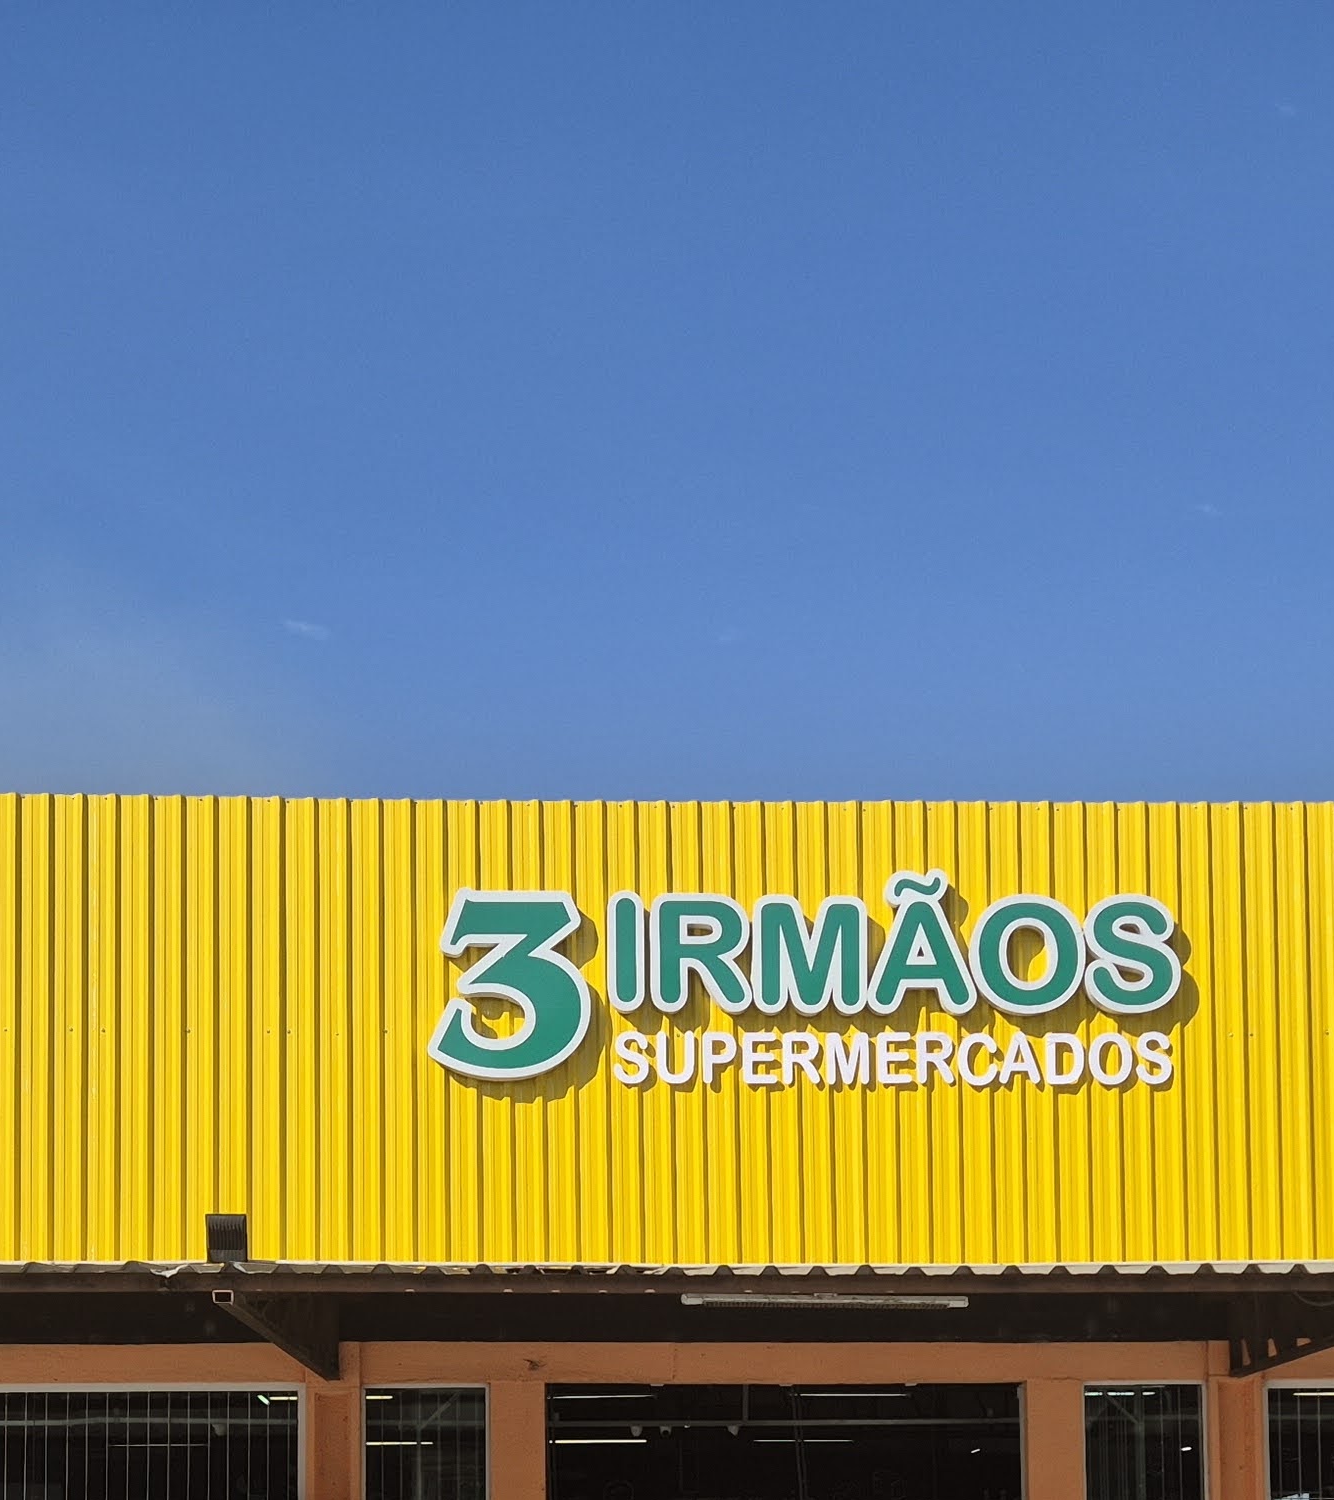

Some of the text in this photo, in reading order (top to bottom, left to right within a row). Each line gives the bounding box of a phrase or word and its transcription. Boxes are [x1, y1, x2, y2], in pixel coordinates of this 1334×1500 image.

[428, 868, 1181, 1080] 3 IRMÃOS
[614, 1031, 1173, 1086] SUPERMERCADOS
